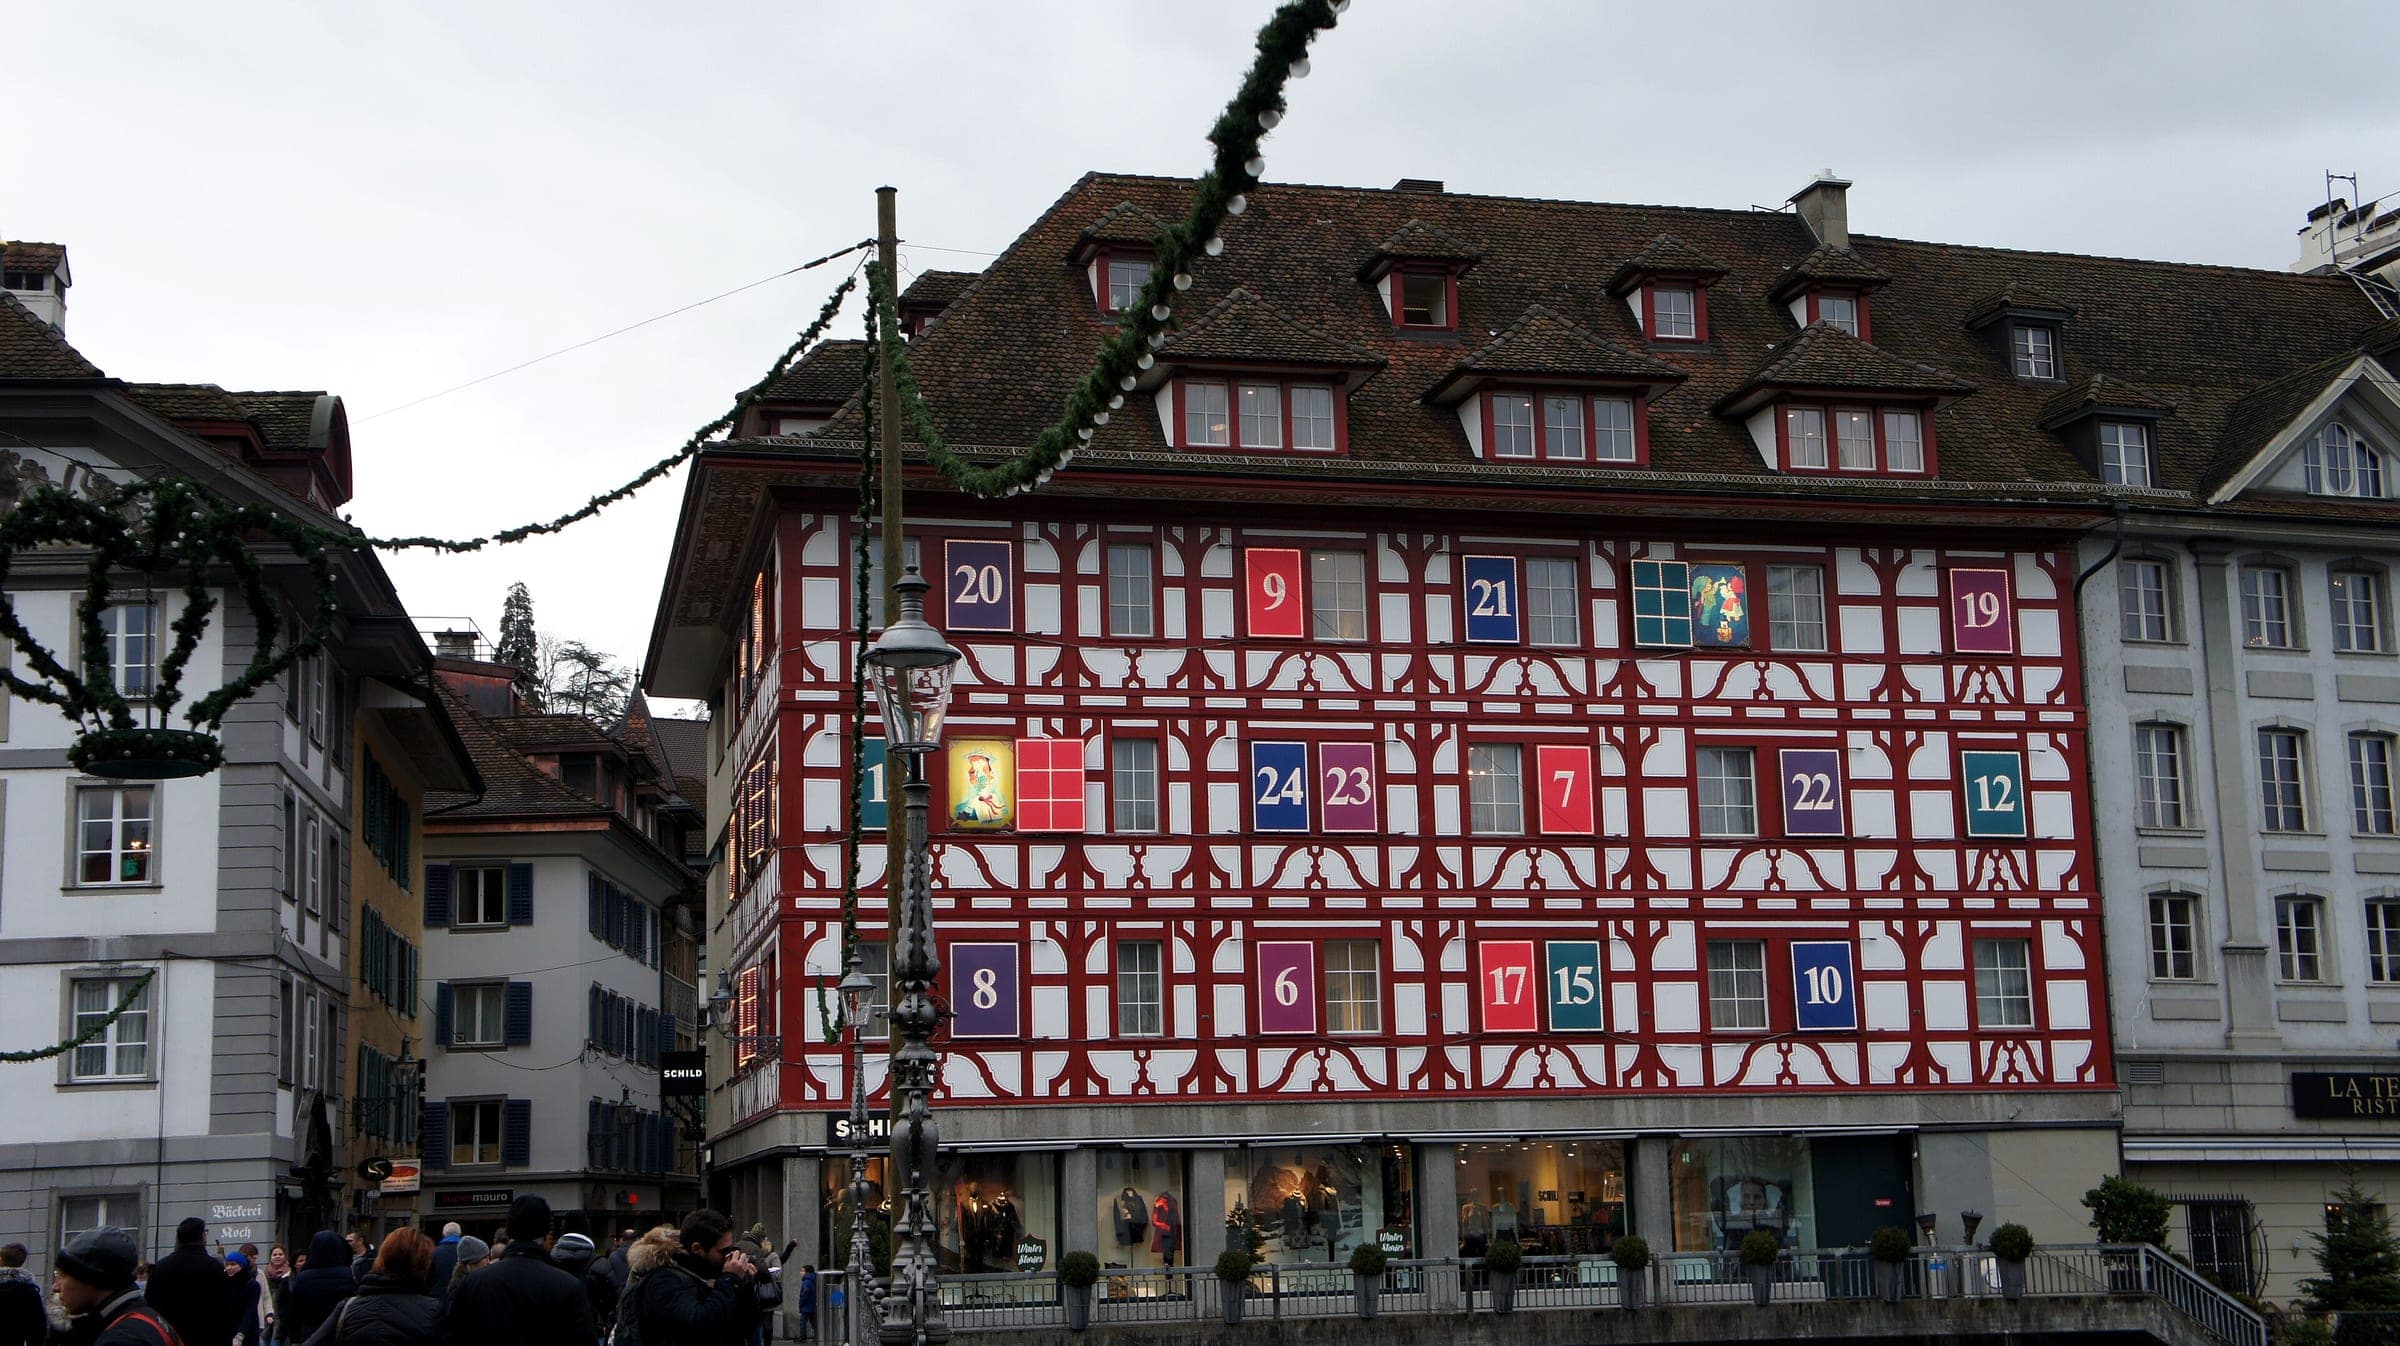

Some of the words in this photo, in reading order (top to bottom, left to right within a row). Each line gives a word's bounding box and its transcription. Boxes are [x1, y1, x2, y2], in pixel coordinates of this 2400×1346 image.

[955, 565, 1002, 603] 20
[1264, 573, 1285, 610] 9
[1472, 580, 1511, 616] 21
[1962, 592, 1999, 627] 19
[1258, 767, 1303, 805] 24
[1327, 767, 1371, 805] 23
[1554, 771, 1574, 807] 7
[1792, 774, 1834, 810] 22
[1975, 776, 2014, 811] 12
[974, 969, 997, 1008] 8
[1275, 967, 1297, 1005] 6
[1490, 967, 1526, 1004] 17
[1555, 967, 1594, 1004] 15
[1804, 966, 1841, 1003] 10
[663, 1069, 702, 1078] SCHILD
[2328, 1077, 2361, 1097] LA
[2369, 1077, 2400, 1098] TE
[2353, 1098, 2398, 1113] RIST
[835, 1119, 891, 1137] SHI
[212, 1203, 262, 1218] Bäckerei
[221, 1226, 251, 1239] Koch
